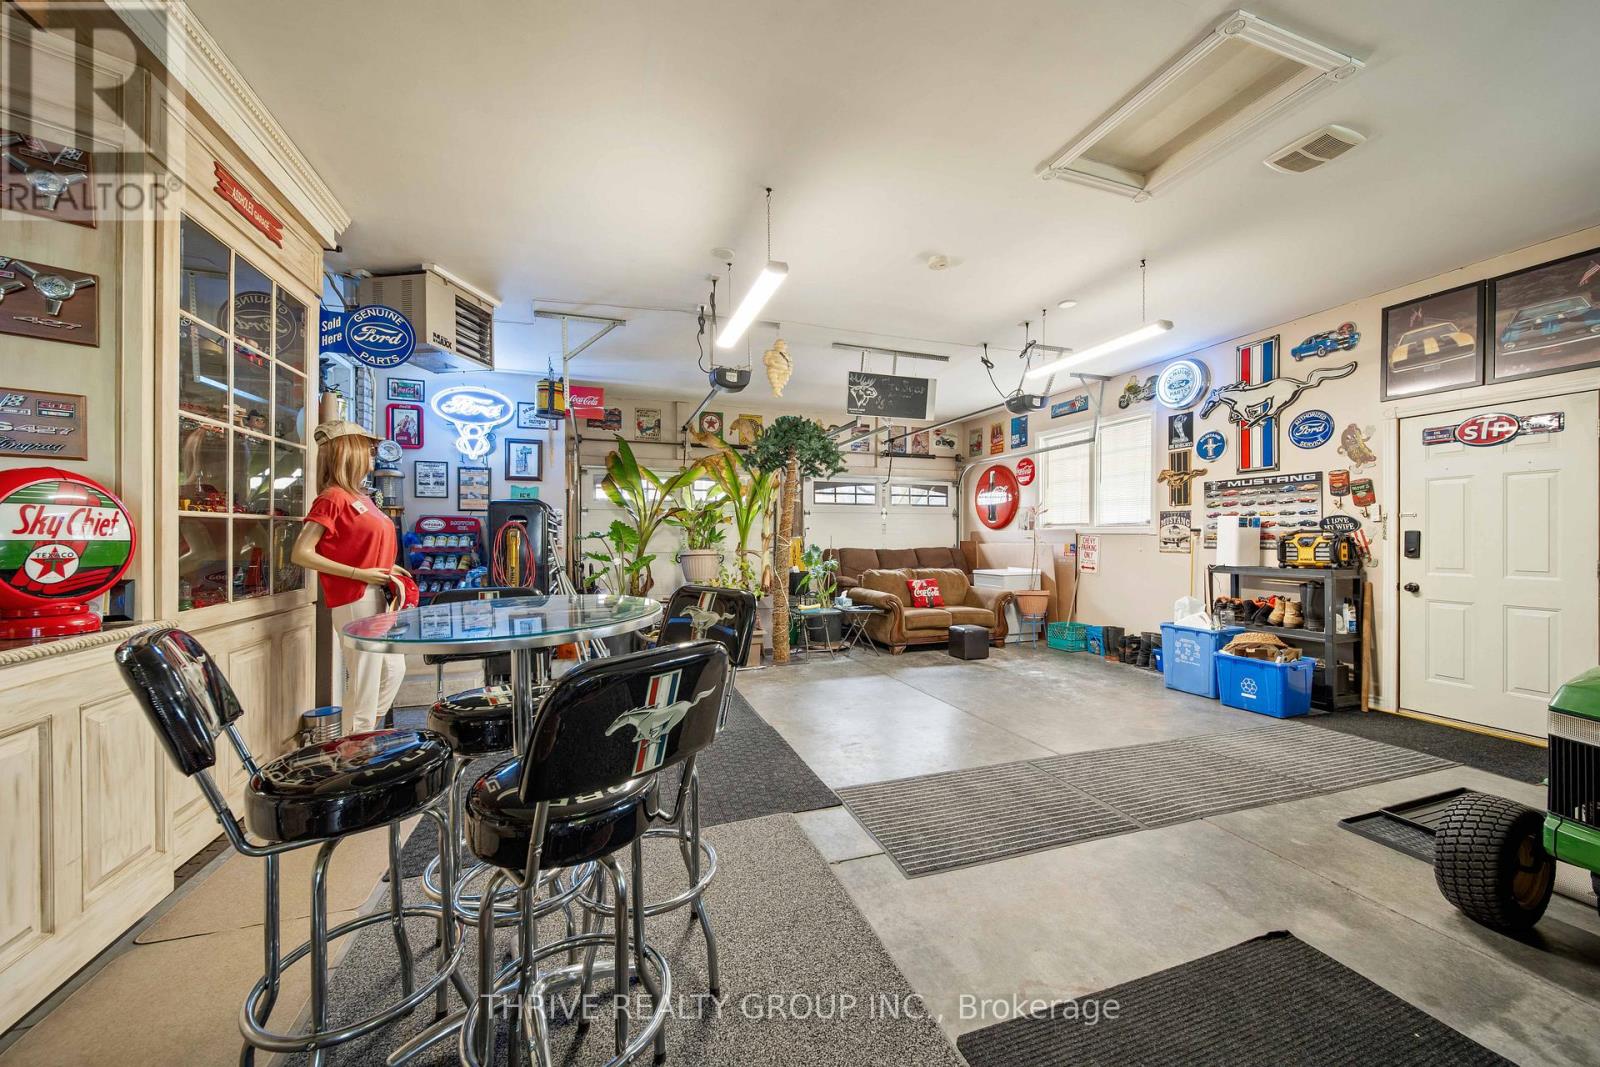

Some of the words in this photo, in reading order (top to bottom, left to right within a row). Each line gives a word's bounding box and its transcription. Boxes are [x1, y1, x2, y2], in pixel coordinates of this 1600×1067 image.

[321, 316, 341, 332] Sold
[353, 308, 405, 326] GENUINE
[321, 332, 342, 346] Here
[353, 325, 404, 345] Ford
[360, 351, 400, 365] PARTS
[1295, 422, 1325, 436] Ford
[1463, 415, 1511, 441] STP
[1227, 473, 1316, 488] MUSTANG
[12, 504, 65, 539] Sky
[66, 507, 120, 537] Chief
[1331, 517, 1350, 525] LOVE
[1335, 522, 1355, 530] WIFE
